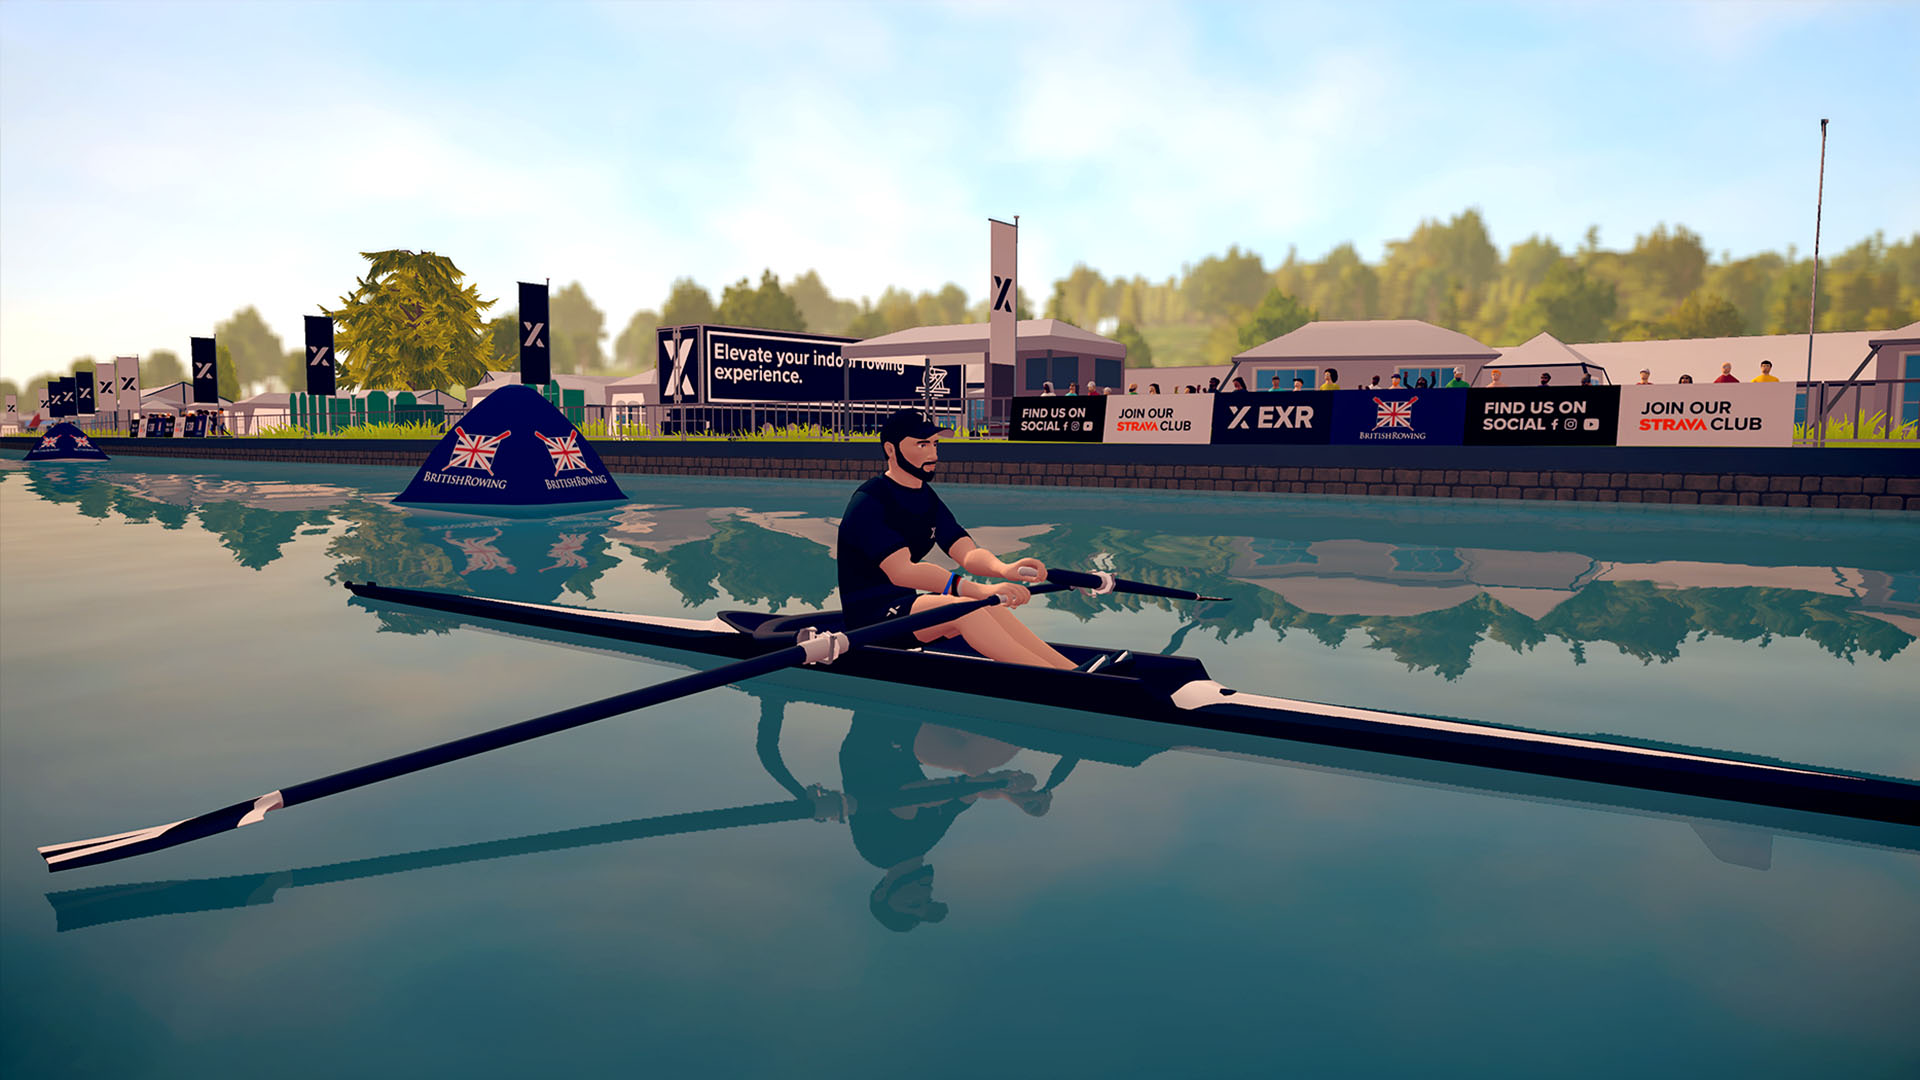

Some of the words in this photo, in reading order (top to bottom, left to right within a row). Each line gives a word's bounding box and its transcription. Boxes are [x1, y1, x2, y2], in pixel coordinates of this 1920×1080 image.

[715, 343, 772, 363] Elevate
[776, 352, 809, 367] your
[715, 365, 802, 384] experience.
[1022, 408, 1048, 418] FIND
[1051, 408, 1065, 418] US
[1068, 408, 1085, 418] ON
[1119, 409, 1145, 418] JOIN
[1148, 408, 1173, 418] OUR
[1485, 402, 1525, 414] FIND
[1531, 401, 1554, 414] US
[1559, 401, 1586, 413] ON
[1641, 402, 1684, 415] JOIN
[1690, 401, 1731, 414] OUR
[1258, 406, 1313, 428] EXR
[1021, 421, 1060, 431] SOCIAL
[1117, 422, 1158, 431] STRAVA
[1160, 421, 1191, 431] CLUB
[1483, 418, 1546, 430] SOCIAL
[1640, 418, 1707, 431] STRAVA
[1711, 418, 1762, 430] CLUB
